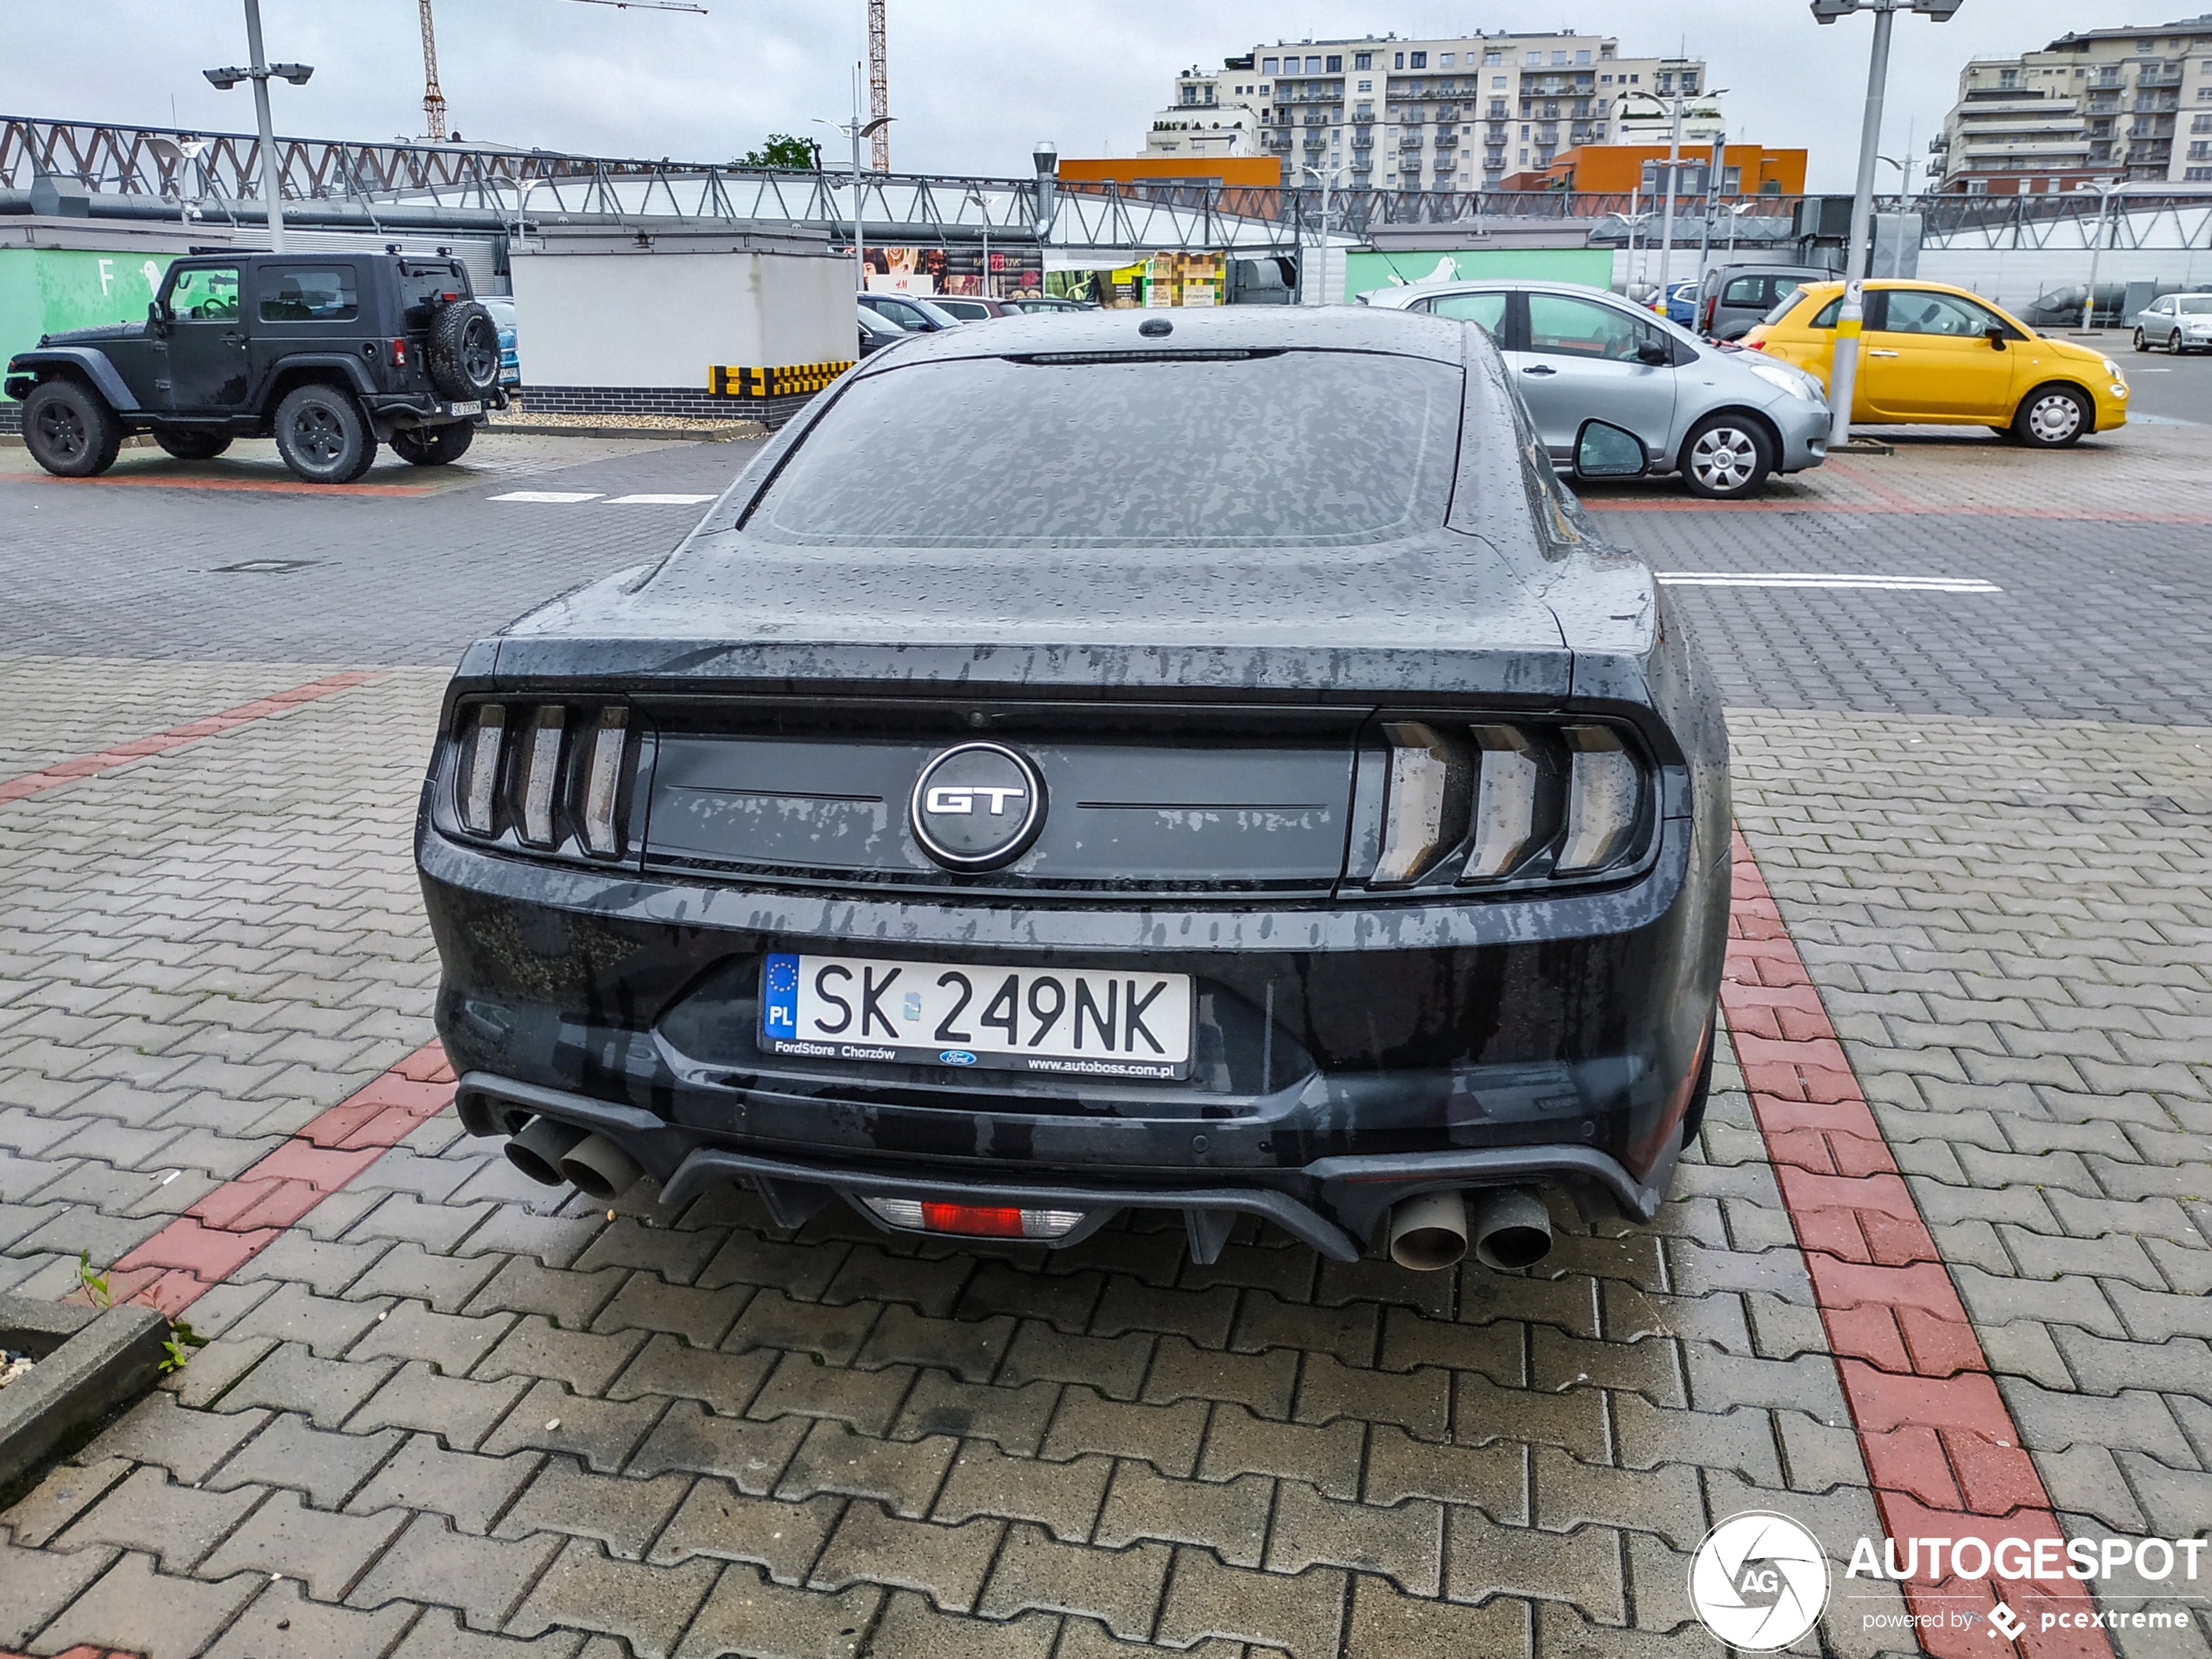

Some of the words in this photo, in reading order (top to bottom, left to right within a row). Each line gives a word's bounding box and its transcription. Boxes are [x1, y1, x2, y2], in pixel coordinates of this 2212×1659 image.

[98, 259, 114, 296] F
[454, 404, 462, 415] SK
[927, 787, 1025, 815] GT
[769, 1005, 793, 1027] PL
[813, 964, 903, 1039] SK
[934, 970, 1168, 1055] 249NK
[774, 1041, 835, 1057] FordStore
[841, 1045, 896, 1061] Chorzów
[944, 1051, 971, 1064] Ford
[1028, 1057, 1175, 1078] www.autoboss.com.pl
